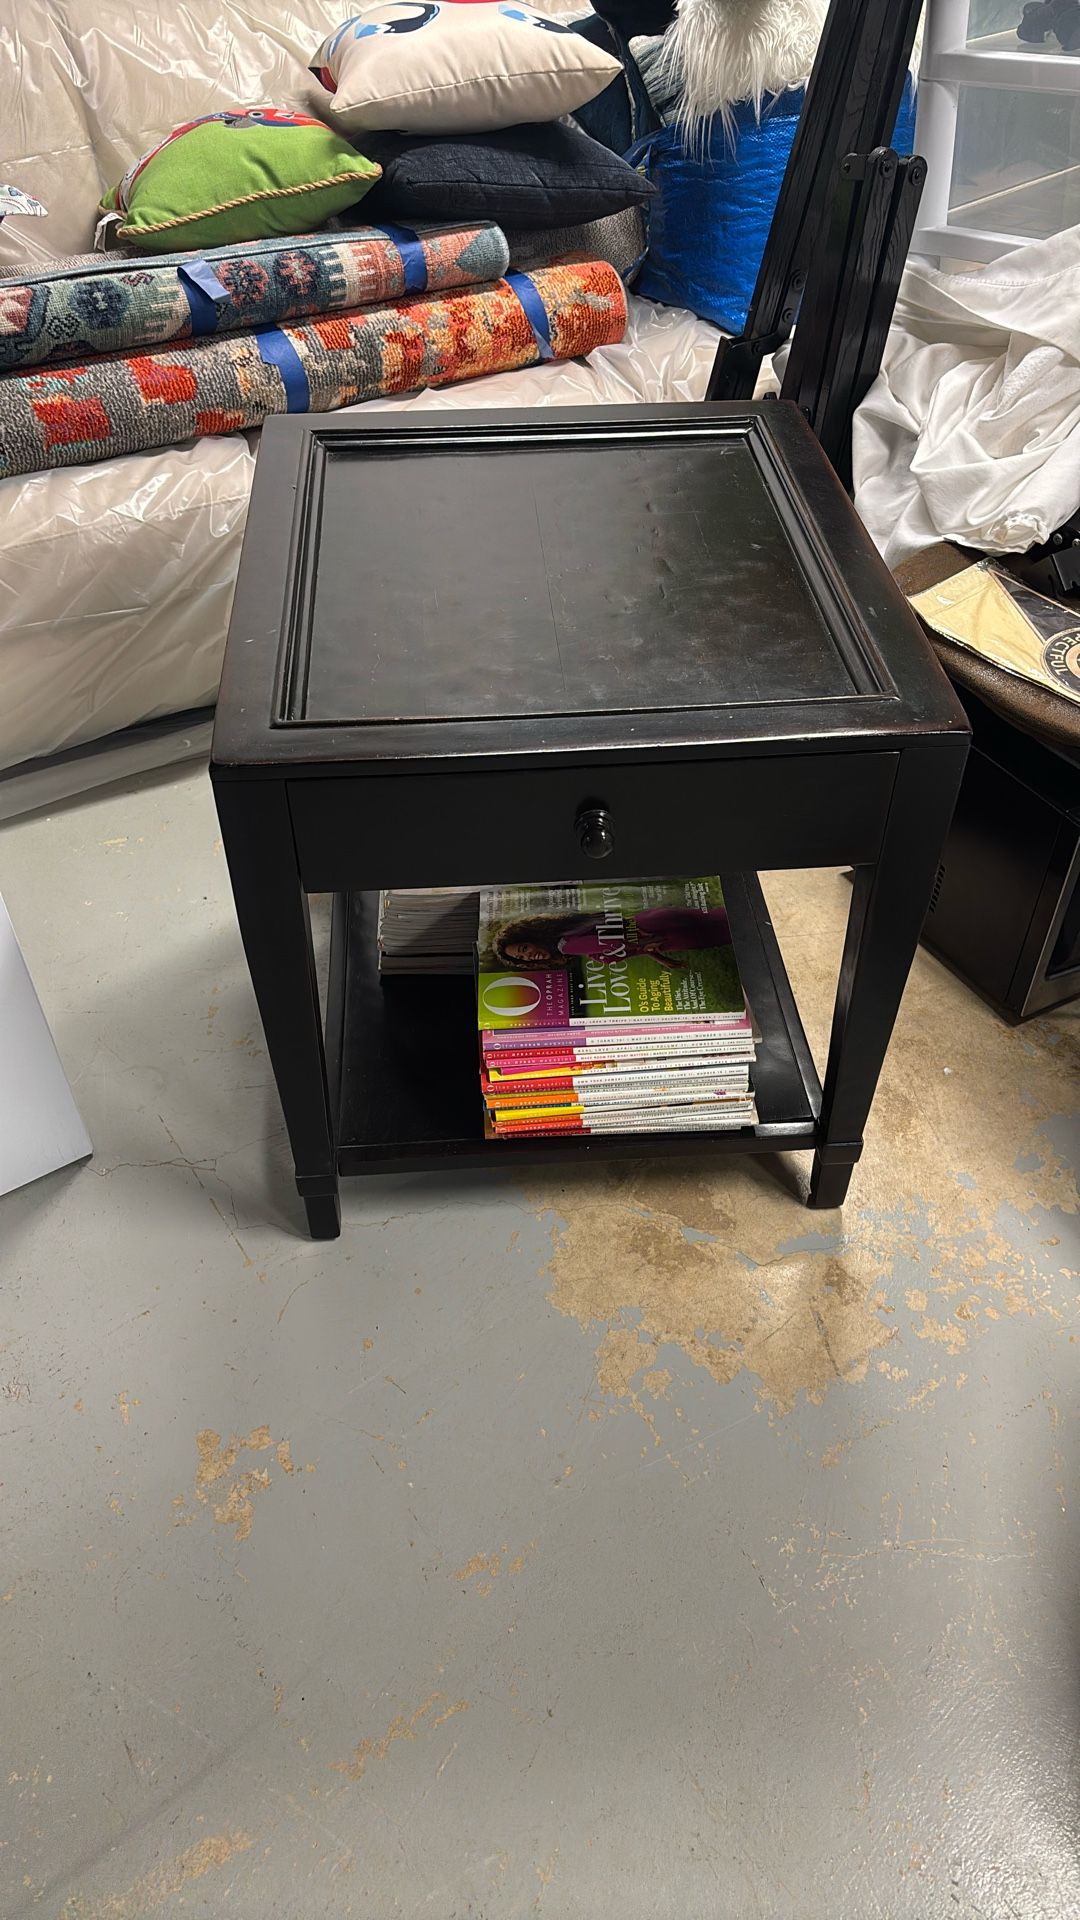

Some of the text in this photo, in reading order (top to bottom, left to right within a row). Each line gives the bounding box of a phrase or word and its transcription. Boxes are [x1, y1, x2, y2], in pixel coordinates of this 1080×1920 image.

[595, 886, 625, 946] Thrive
[603, 943, 627, 958] &
[482, 976, 542, 1016] O
[545, 973, 553, 1016] THE OPRAH
[556, 973, 565, 1016] MAGAZINE
[602, 959, 632, 1014] Love
[635, 977, 649, 1013] O's Guide
[648, 979, 662, 1012] To Aging
[658, 969, 674, 1012] Beautifully
[683, 1001, 691, 1010] The
[698, 1000, 707, 1010] The
[675, 1001, 683, 1011] The
